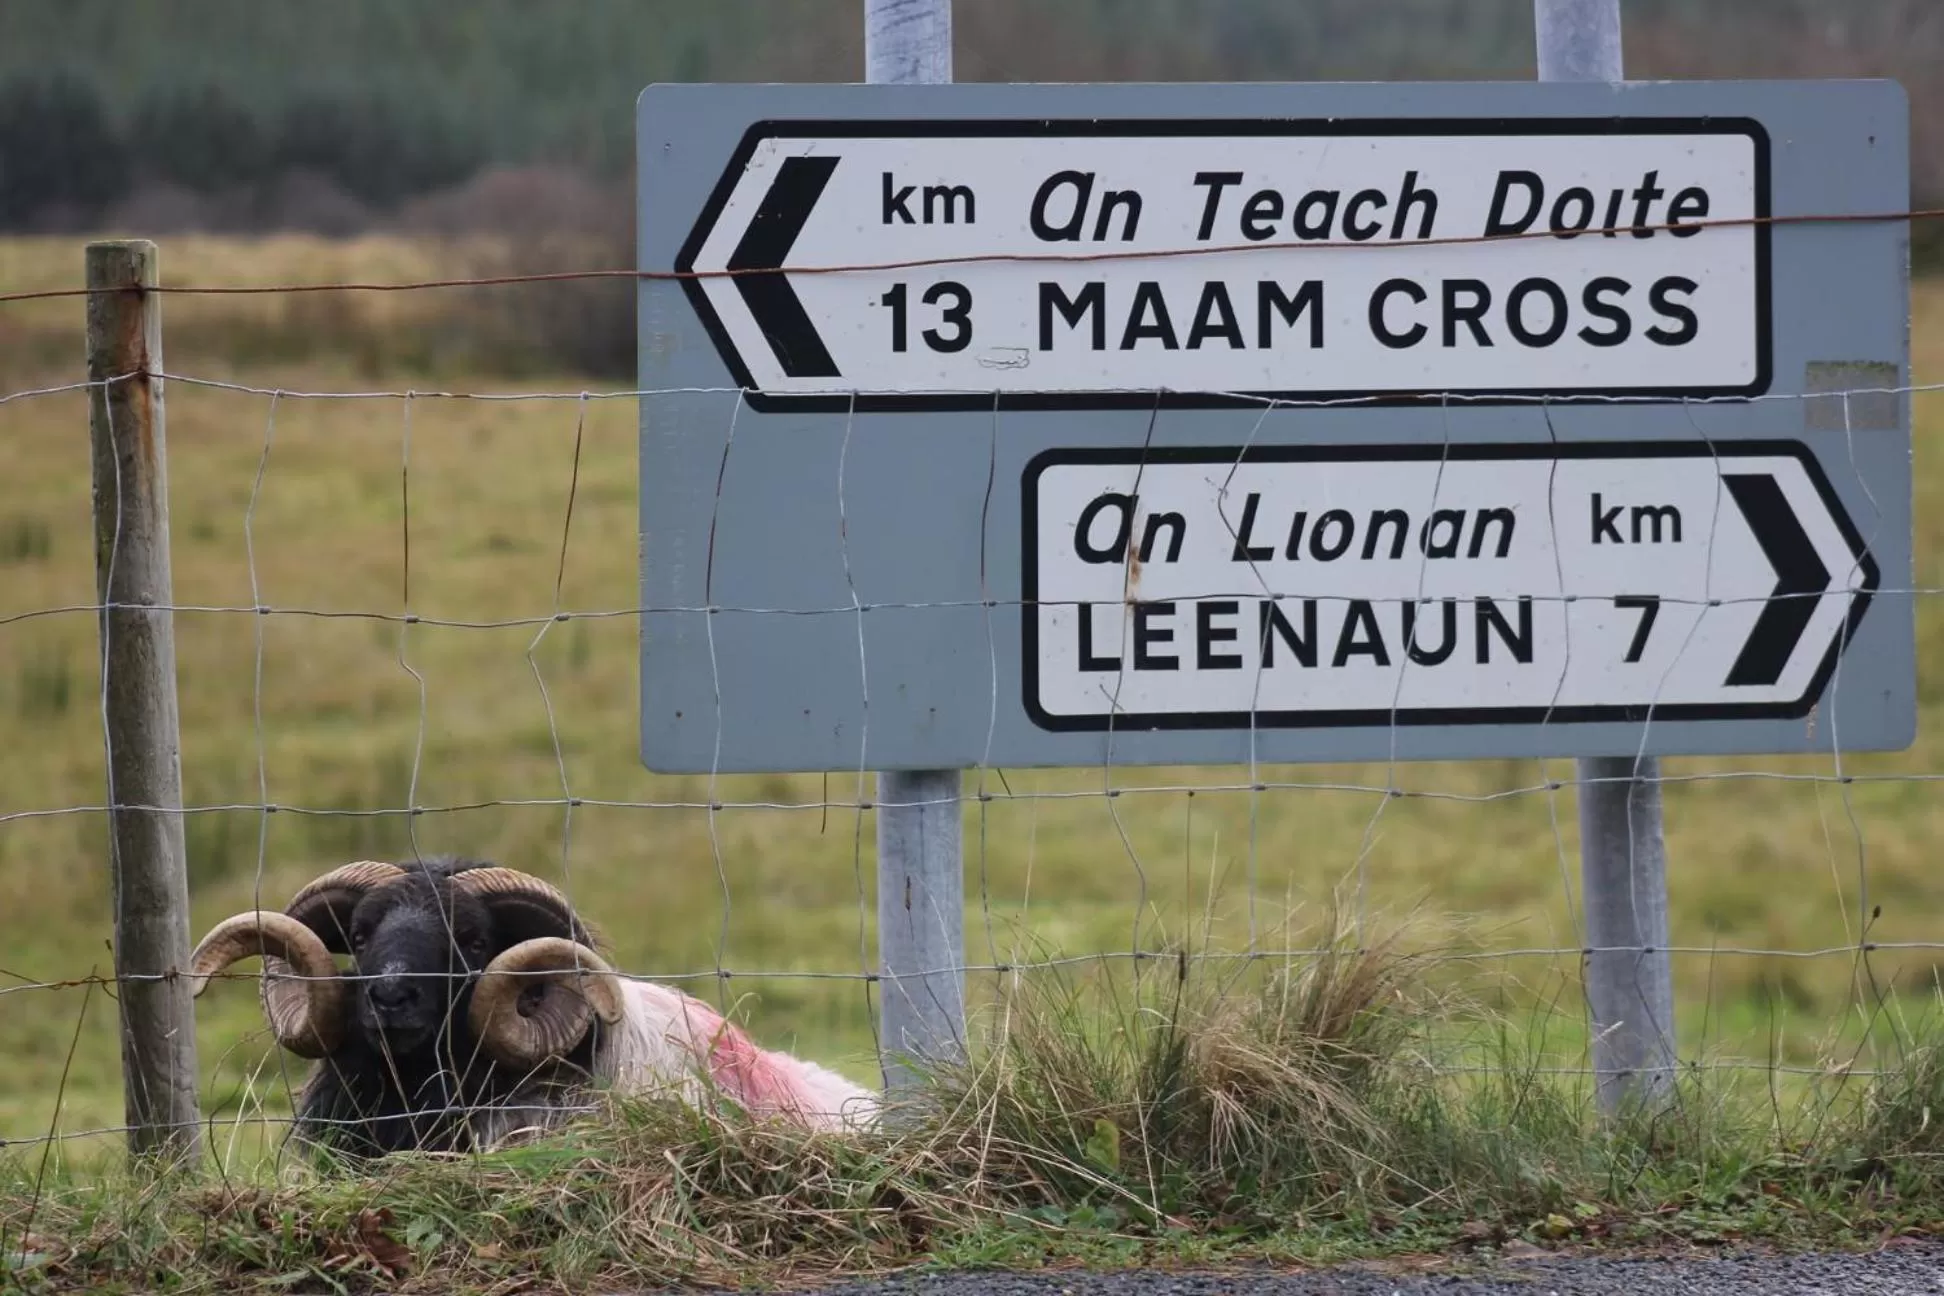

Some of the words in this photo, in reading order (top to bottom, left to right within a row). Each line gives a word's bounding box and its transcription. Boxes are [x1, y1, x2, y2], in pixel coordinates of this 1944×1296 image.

[882, 172, 976, 225] km
[1193, 170, 1438, 242] Teach
[881, 281, 973, 353] 13
[1038, 281, 1324, 351] MAAM
[1368, 276, 1699, 349] CROSS
[1590, 492, 1683, 545] km
[1077, 595, 1534, 672] LEENAUN
[1614, 595, 1660, 664] 7
